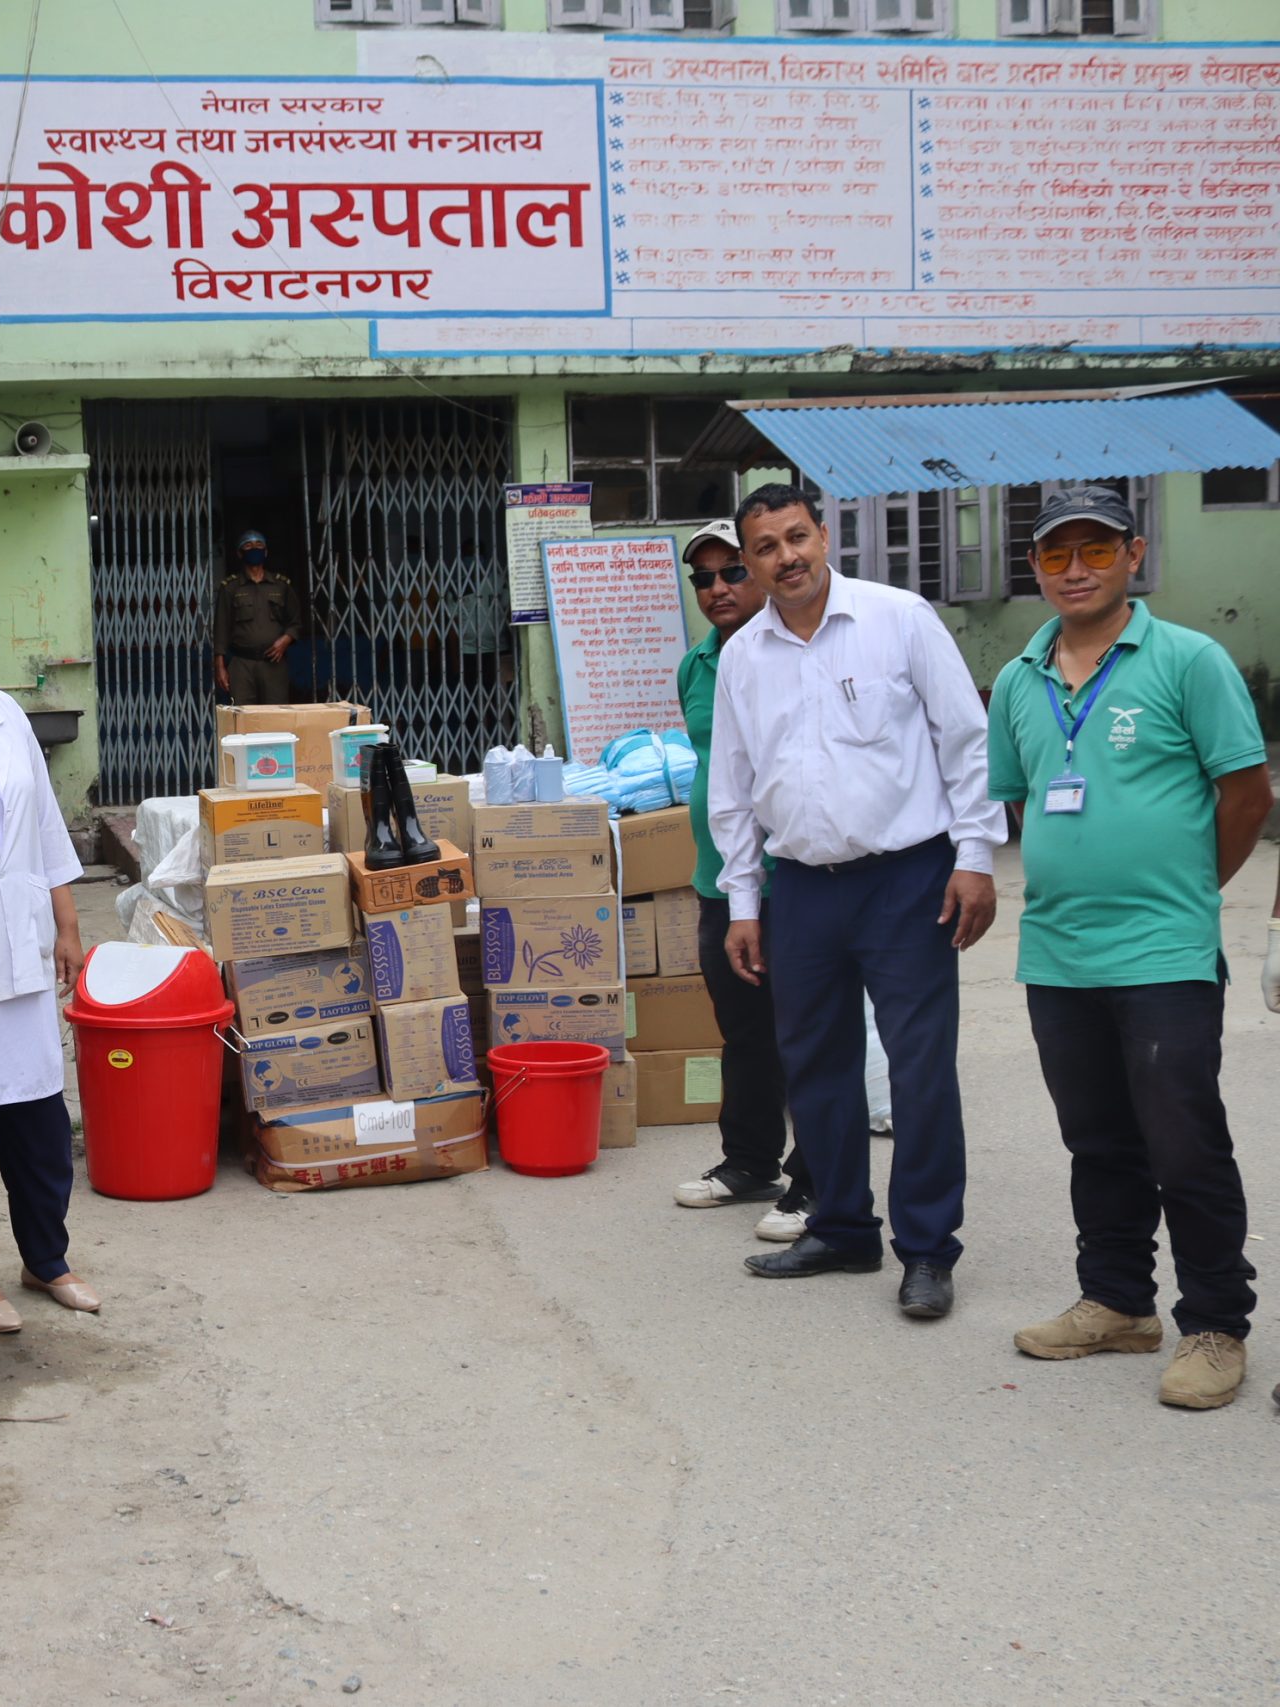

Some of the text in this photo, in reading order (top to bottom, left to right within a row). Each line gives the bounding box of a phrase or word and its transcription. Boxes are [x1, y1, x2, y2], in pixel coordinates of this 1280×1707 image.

[877, 54, 949, 85] समिति
[1006, 63, 1063, 87] प्रदान
[1135, 63, 1192, 92] प्रमुख
[202, 90, 384, 115] नेपाल सरकार
[45, 121, 544, 153] स्वास्थ्य तथा जनसंख्या मन्त्रालय
[231, 183, 591, 251] अस्पताल
[801, 242, 836, 263] रोग
[172, 258, 433, 302] विराटनगर
[248, 801, 282, 810] Lifeline
[424, 794, 454, 802] Care
[267, 833, 277, 846] L
[592, 855, 603, 865] M
[253, 886, 325, 900] BSC Care
[486, 911, 501, 981] BLOSSOM
[370, 924, 393, 998] BLOSSOM
[498, 993, 547, 1002] TOP GLOVE
[607, 994, 618, 1004] M
[320, 1003, 369, 1018] TOP GLOVE
[357, 1028, 366, 1039] L
[549, 1021, 561, 1031] CE
[265, 1037, 296, 1048] GLOVE
[453, 1007, 473, 1080] BLOSSOM
[358, 1109, 410, 1132] Cmd-100
